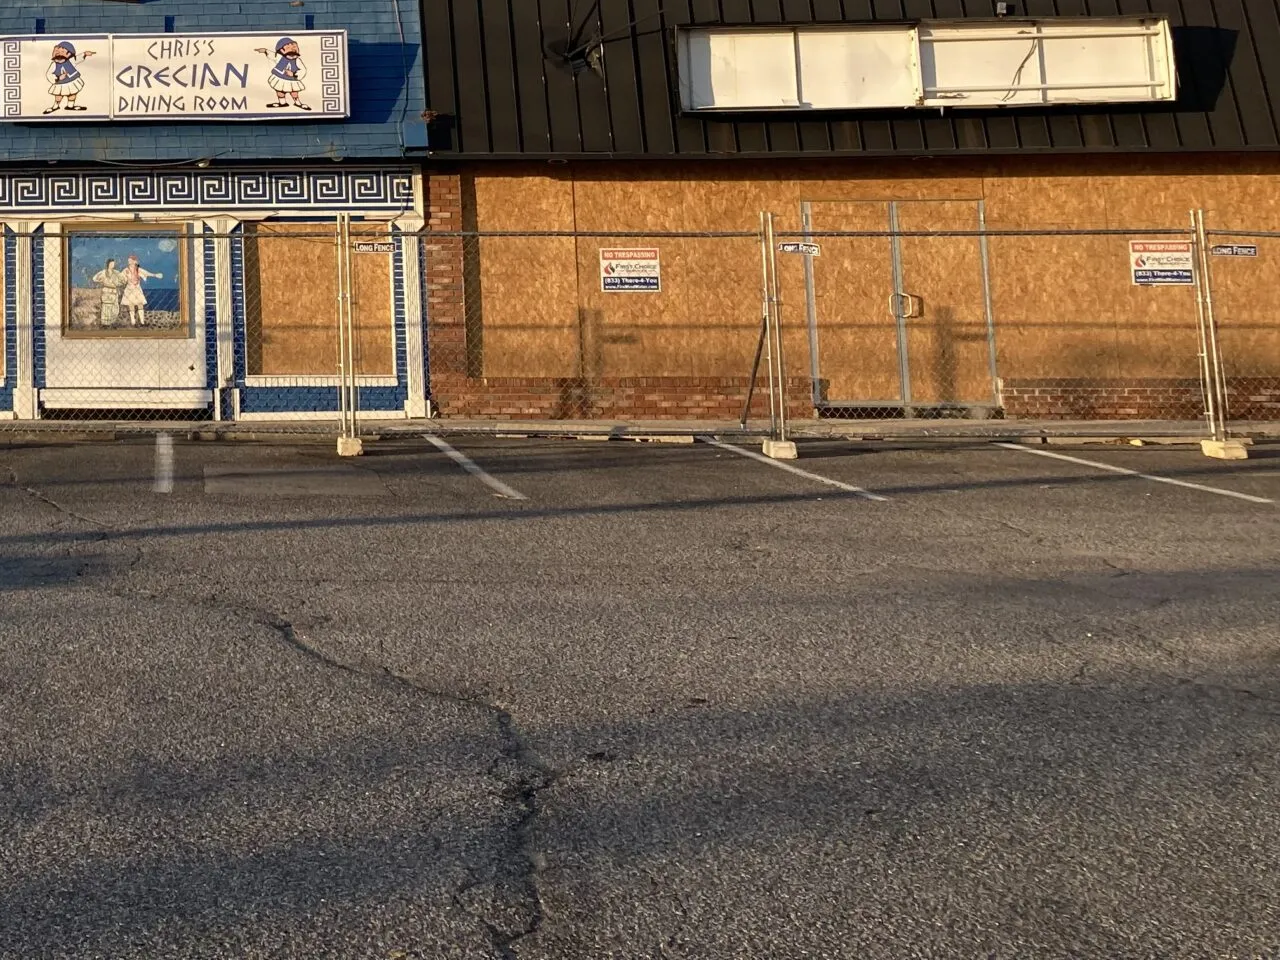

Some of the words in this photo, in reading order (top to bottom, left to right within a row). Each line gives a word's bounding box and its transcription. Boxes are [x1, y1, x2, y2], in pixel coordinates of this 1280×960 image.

[147, 39, 215, 61] CHRIS'S
[116, 62, 249, 90] GRECIAN
[119, 95, 185, 112] DINING
[194, 96, 248, 112] ROOM
[355, 243, 373, 251] LONG
[374, 243, 394, 251] FENCE
[1212, 247, 1232, 255] LONG
[1233, 246, 1256, 255] FENCE
